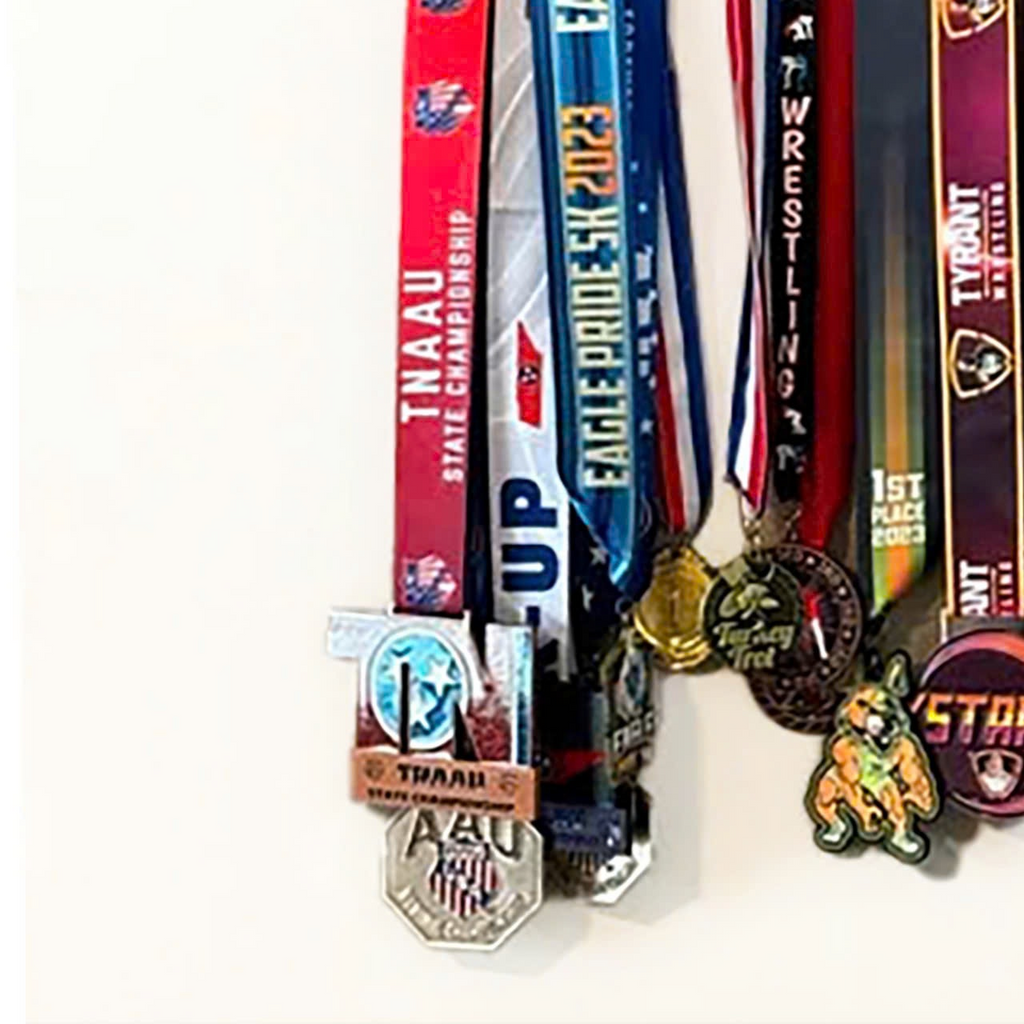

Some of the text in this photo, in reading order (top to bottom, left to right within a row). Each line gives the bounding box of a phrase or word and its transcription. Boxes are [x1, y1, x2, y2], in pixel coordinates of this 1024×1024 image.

[560, 104, 619, 196] 2023
[777, 96, 812, 400] WRESTLING
[949, 183, 982, 307] TYRANT
[401, 270, 443, 424] TNAAU
[442, 208, 474, 483] STATE CHAMPIONSHIP
[570, 261, 626, 370] PRIDE
[578, 374, 630, 488] EAGLE
[872, 469, 925, 502] 1ST
